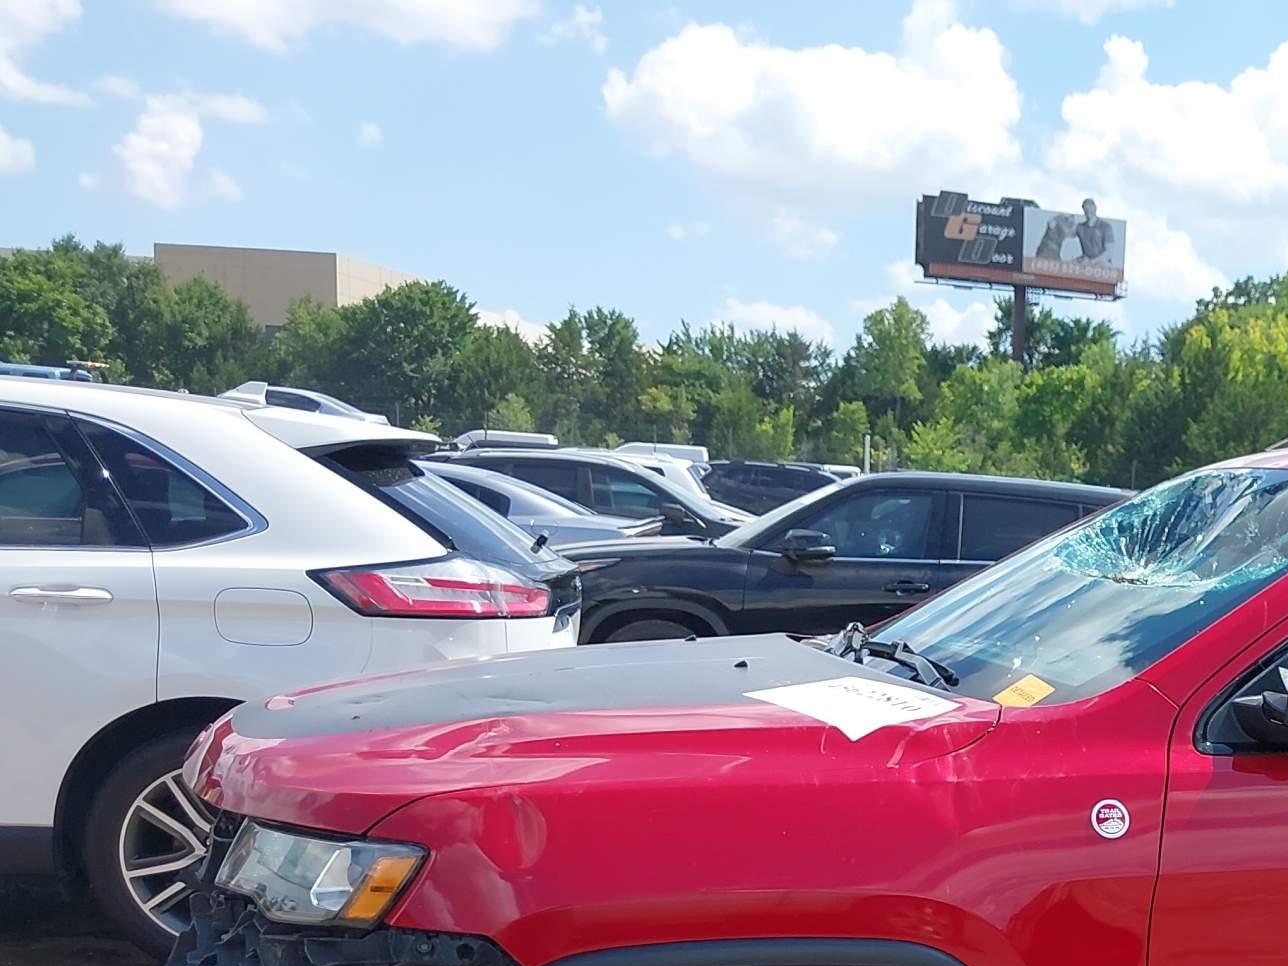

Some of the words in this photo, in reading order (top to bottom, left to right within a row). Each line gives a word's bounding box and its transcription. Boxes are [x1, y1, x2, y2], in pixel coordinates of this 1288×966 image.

[930, 191, 1013, 217] Discount
[943, 210, 1016, 240] Garage
[957, 234, 1014, 264] Door
